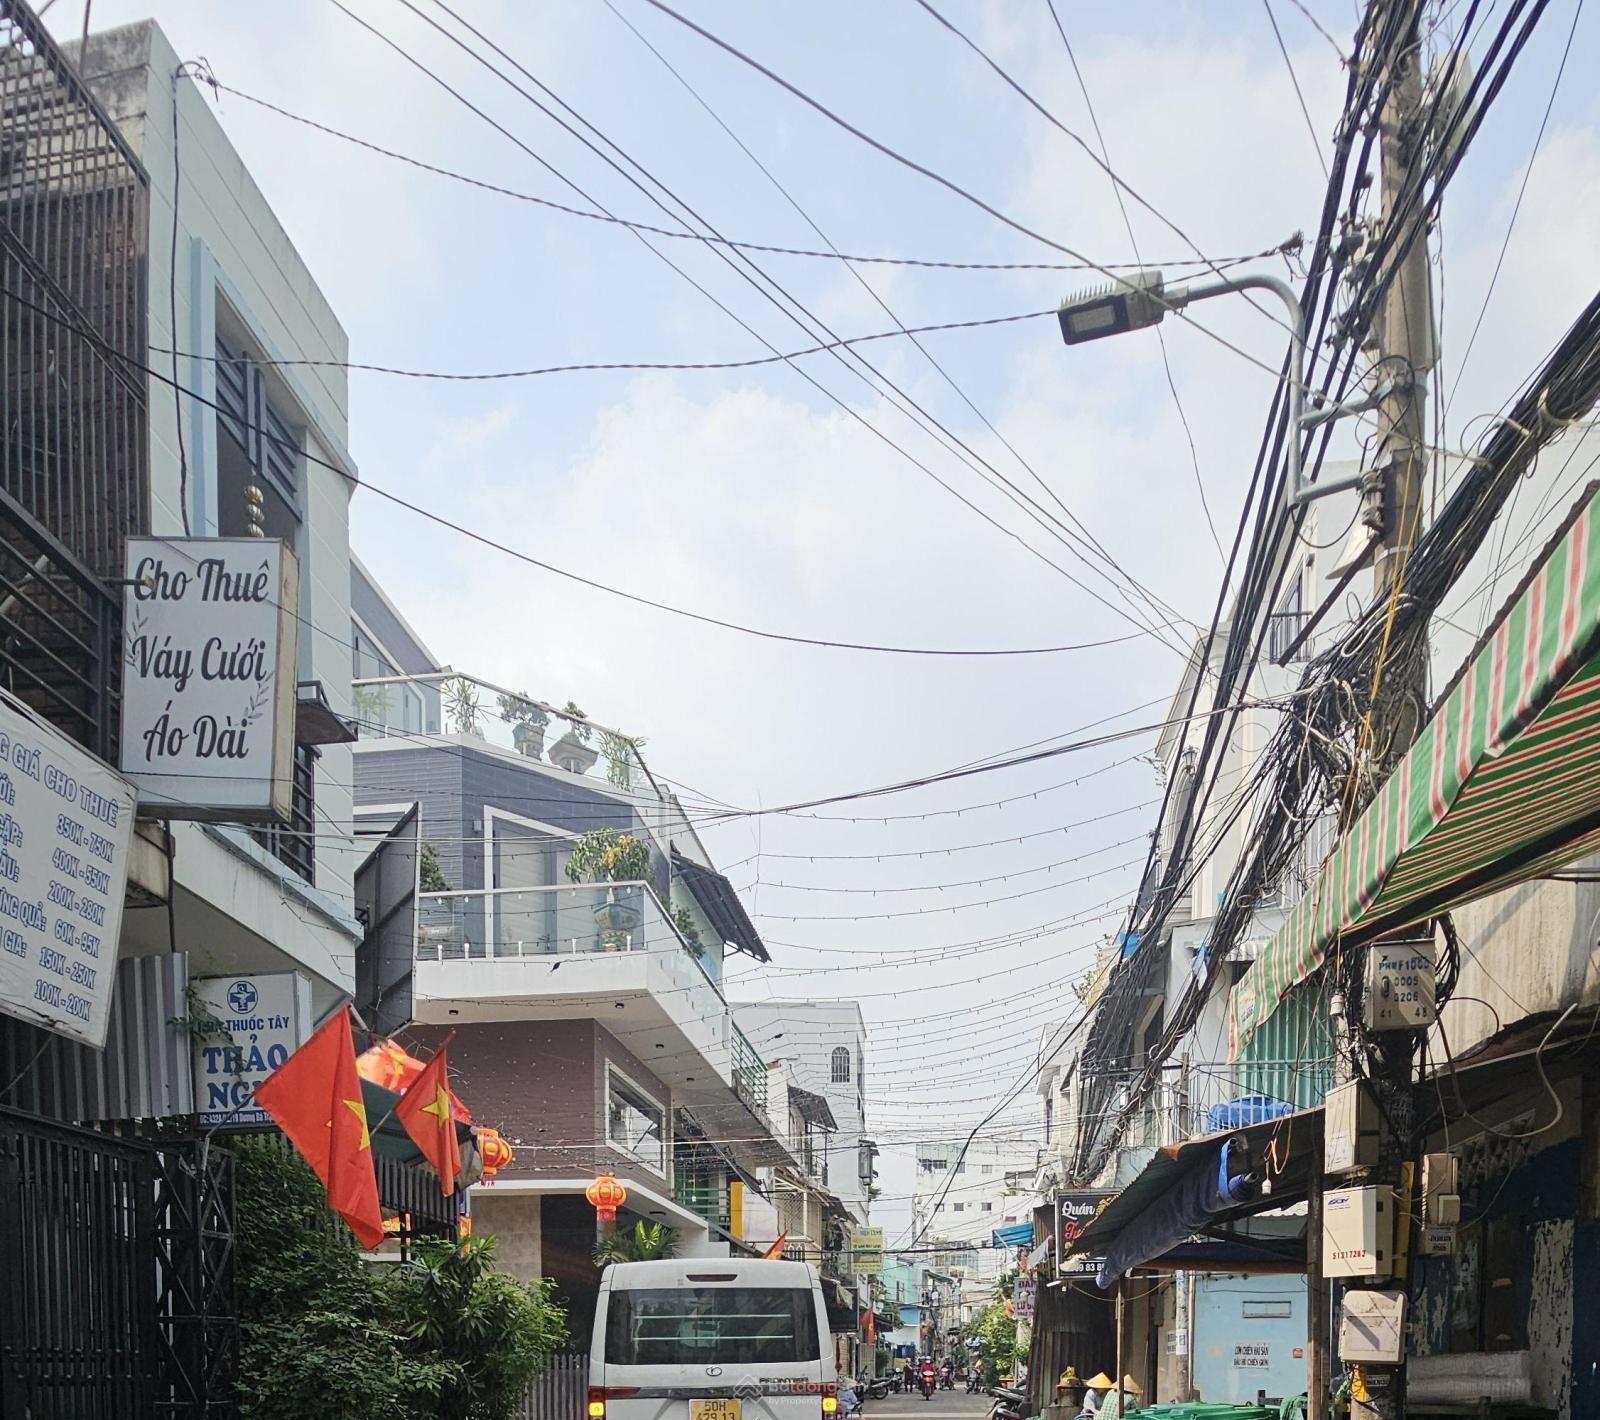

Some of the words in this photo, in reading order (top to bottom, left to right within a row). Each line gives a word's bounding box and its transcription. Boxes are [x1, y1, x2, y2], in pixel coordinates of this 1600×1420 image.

[133, 557, 193, 601] Cho
[197, 559, 269, 602] Thuê
[131, 635, 194, 693] Váy
[201, 637, 267, 681] Cưới
[143, 700, 190, 762] Áo
[193, 715, 249, 759] Dài
[12, 743, 41, 782] GIÁ
[44, 764, 78, 802] CHO
[80, 785, 118, 828] THUÊ
[56, 813, 84, 846] 350K
[89, 832, 115, 863] 750K
[52, 848, 80, 879] 400K
[84, 864, 110, 895] 550K
[47, 880, 75, 911] 200K
[80, 897, 105, 927] 280K
[54, 919, 75, 946] 60K
[80, 932, 100, 958] 95K
[39, 946, 66, 975] 150K
[70, 961, 96, 990] 250K
[34, 979, 61, 1008] 100K
[65, 993, 92, 1021] 200K
[226, 1015, 264, 1032] THUỐC
[268, 1014, 290, 1030] TÂY
[1061, 1201, 1095, 1220] Quán
[704, 1401, 726, 1411] 50H
